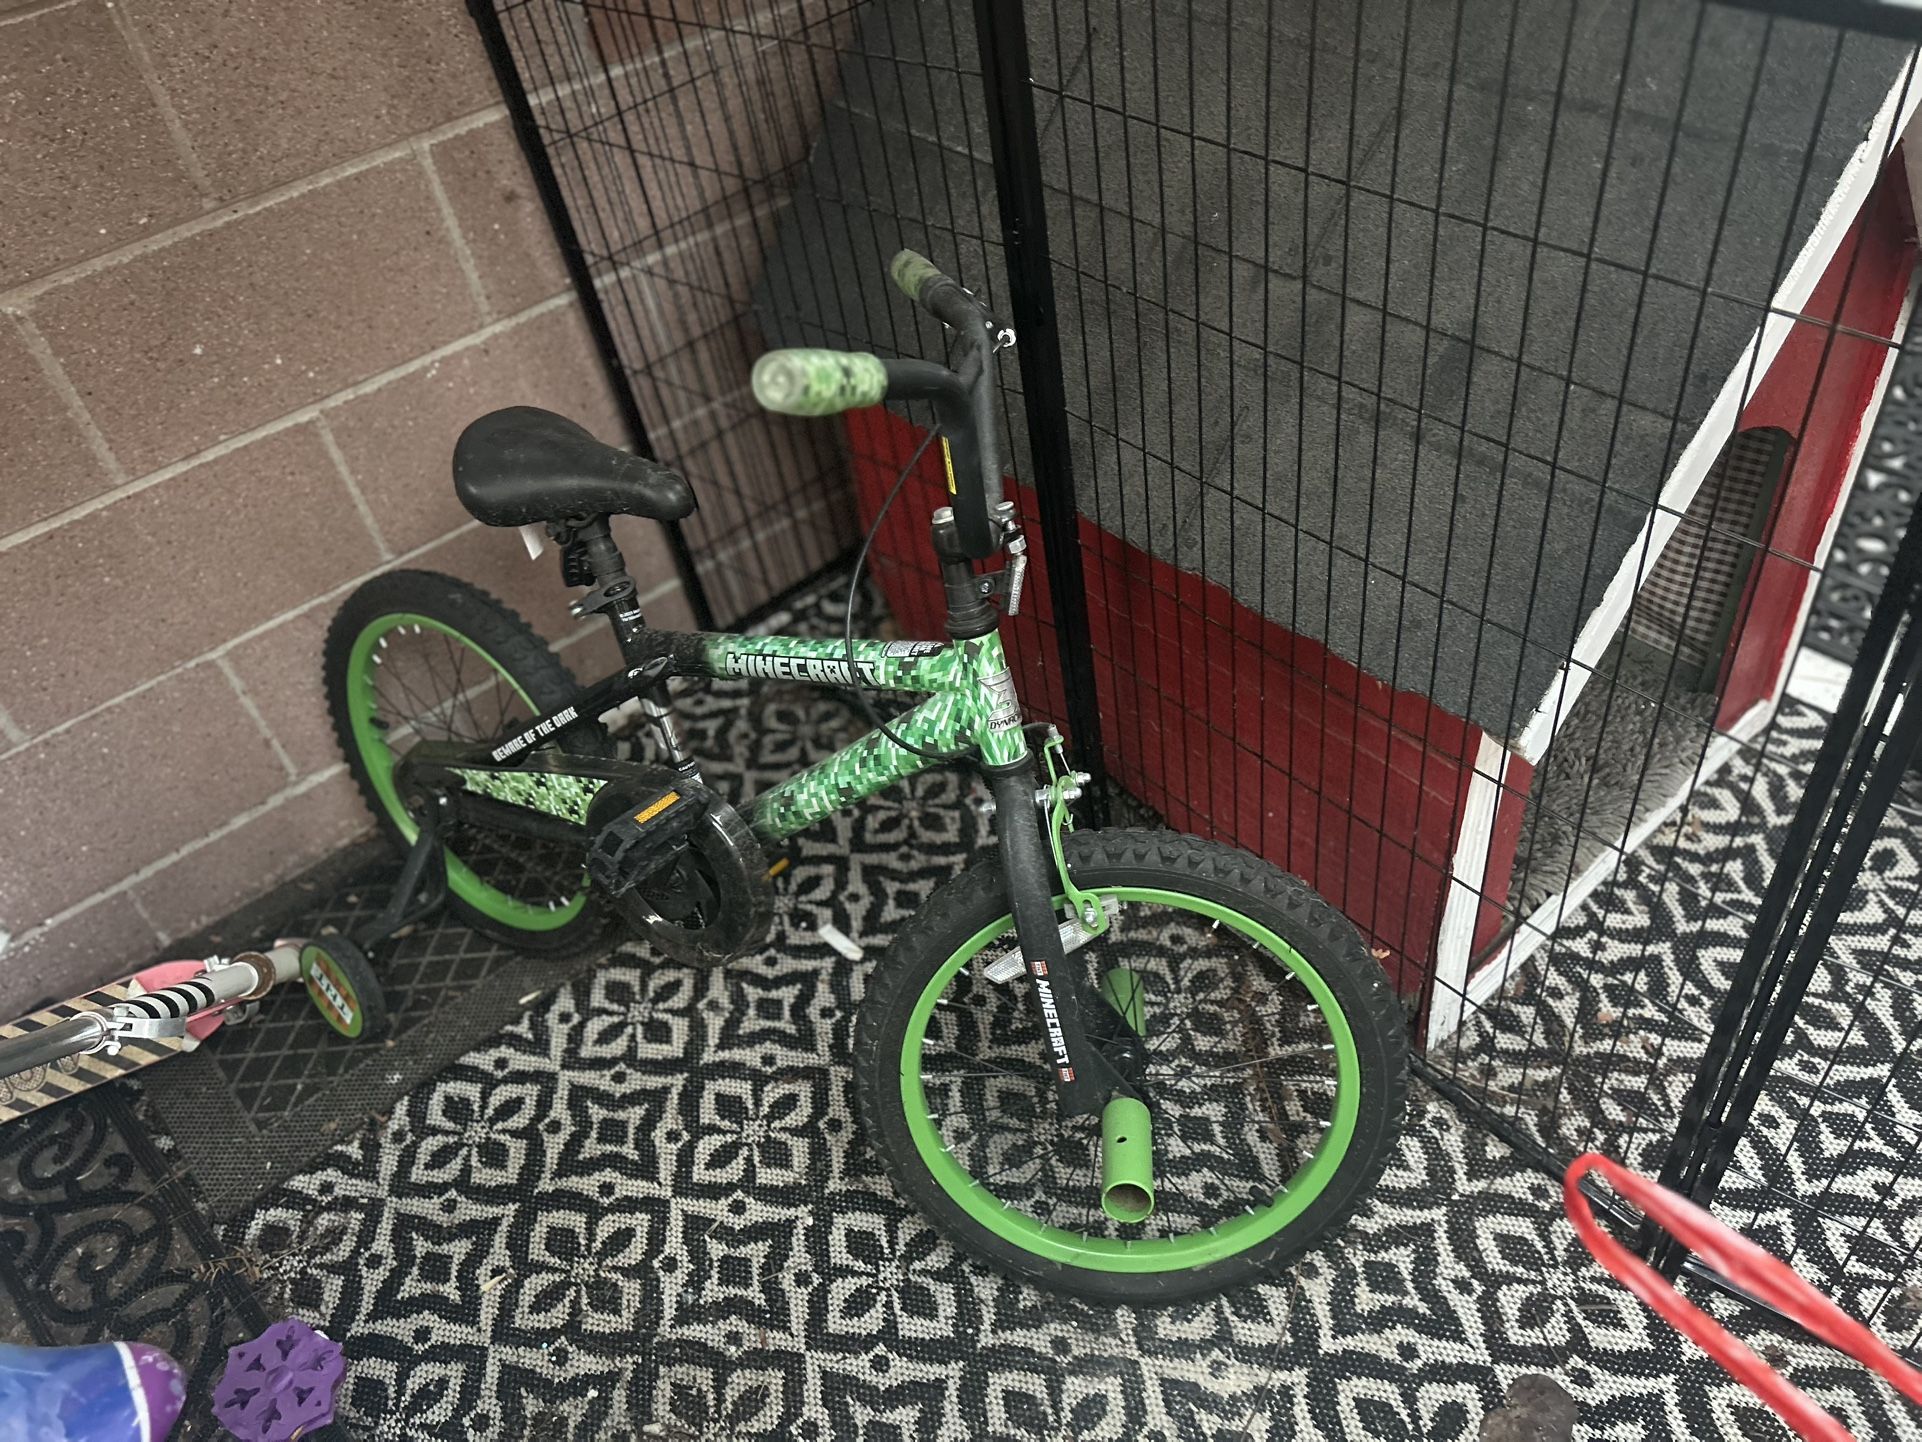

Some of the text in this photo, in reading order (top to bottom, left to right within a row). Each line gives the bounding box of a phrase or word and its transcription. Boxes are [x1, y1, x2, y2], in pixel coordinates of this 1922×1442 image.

[491, 706, 579, 762] BEWARE OF THE DARK
[1035, 978, 1070, 1065] MINECRAFT
